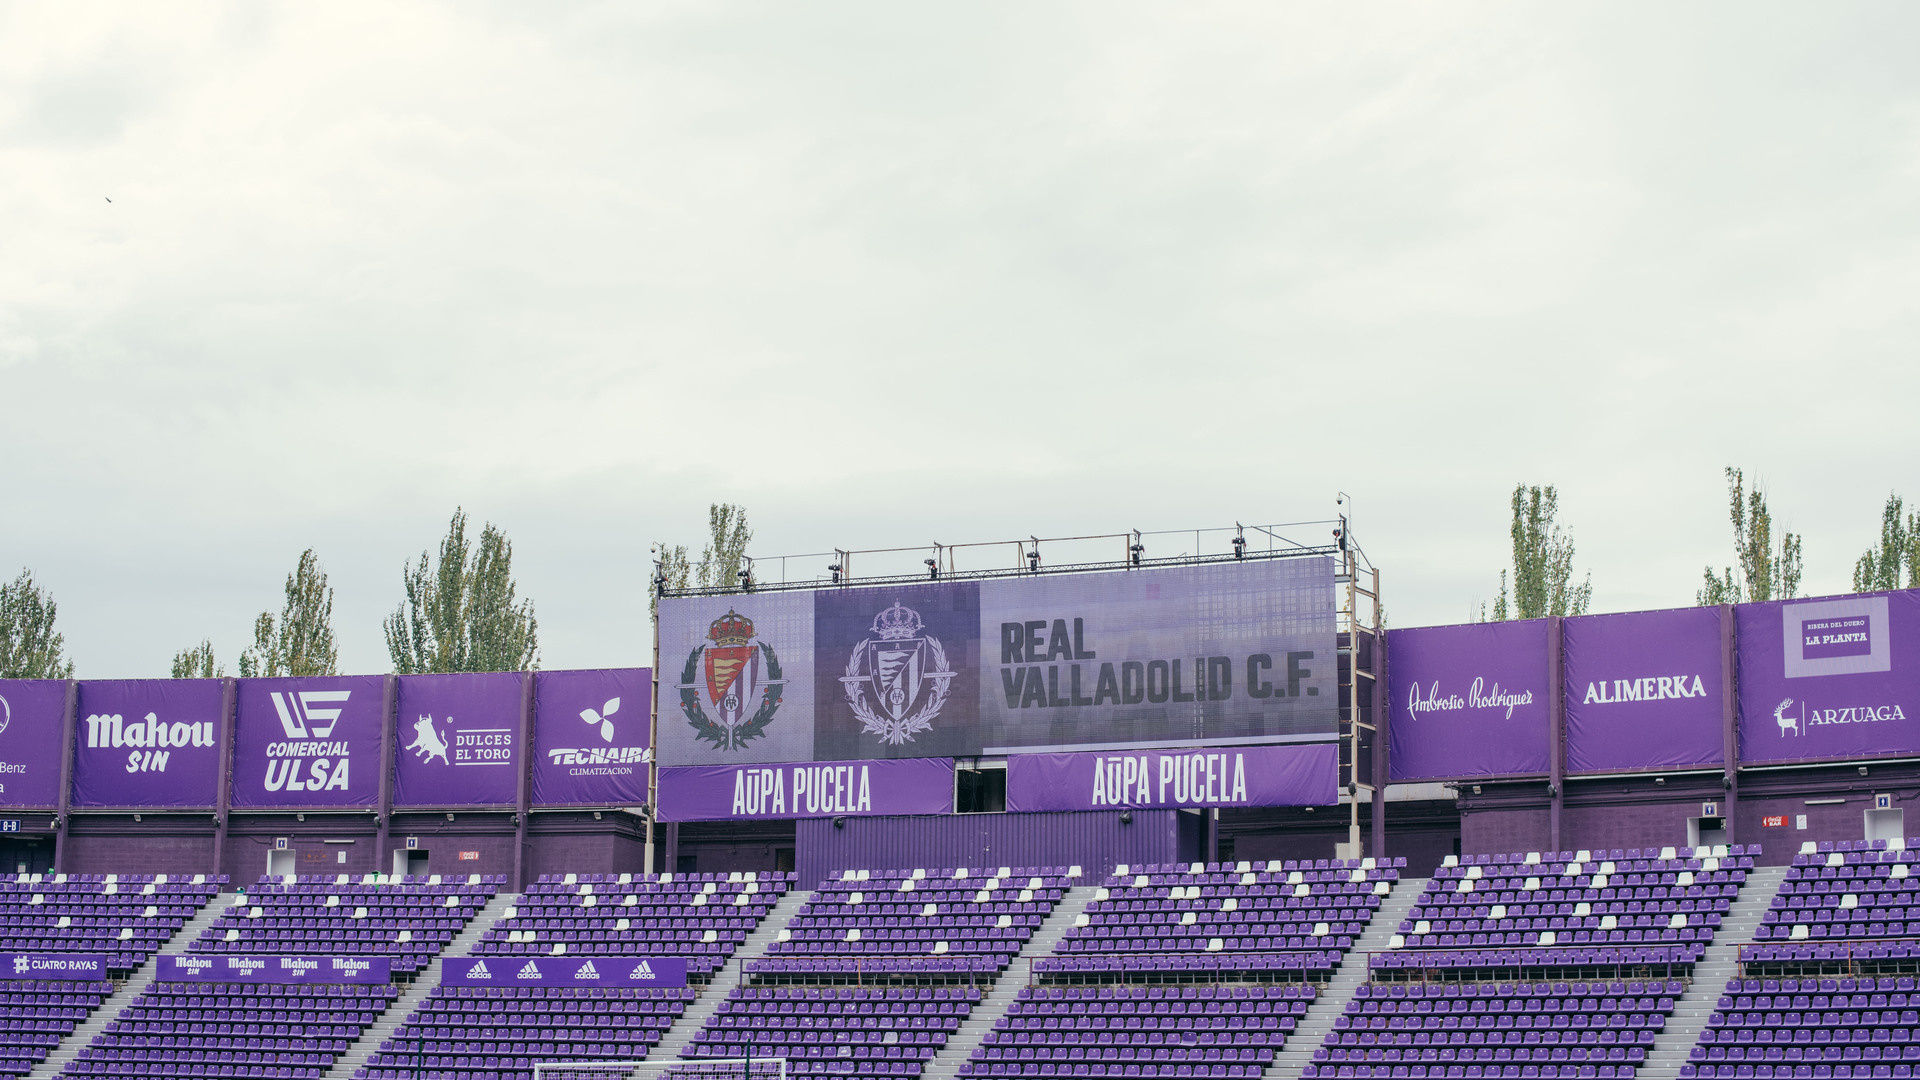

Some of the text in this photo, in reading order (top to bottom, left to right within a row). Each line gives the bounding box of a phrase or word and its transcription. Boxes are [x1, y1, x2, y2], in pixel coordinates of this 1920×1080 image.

[1807, 622, 1829, 630] RIBERA
[1843, 619, 1865, 627] DUERO
[1001, 618, 1096, 664] REAL
[1805, 632, 1868, 646] LA PLANTA
[1000, 650, 1319, 709] VALLADOLID C.F.
[1583, 674, 1706, 705] ALIMERKA
[1407, 676, 1533, 721] Ambrosio Rodríguez
[1808, 704, 1906, 726] ARZUAGA
[86, 712, 215, 748] Mahou
[456, 734, 512, 746] DULCES
[266, 741, 350, 757] COMERCIAL
[455, 748, 511, 761] EL TORO
[126, 750, 171, 773] SIN
[264, 758, 349, 792] ULSA
[569, 767, 633, 776] CLIMATIZACION
[1159, 753, 1247, 804] PUCELA
[793, 765, 871, 814] PUCELA
[3, 821, 17, 831] 8-B
[32, 960, 98, 970] CUATRO RAYAS
[175, 956, 212, 969] Mahou
[228, 957, 265, 969] Mahou
[281, 957, 318, 970] Mahou
[332, 958, 370, 970] Mahou
[466, 971, 492, 980] adidas
[516, 971, 542, 980] adidas
[574, 971, 600, 980] adidas
[629, 971, 655, 980] adidas
